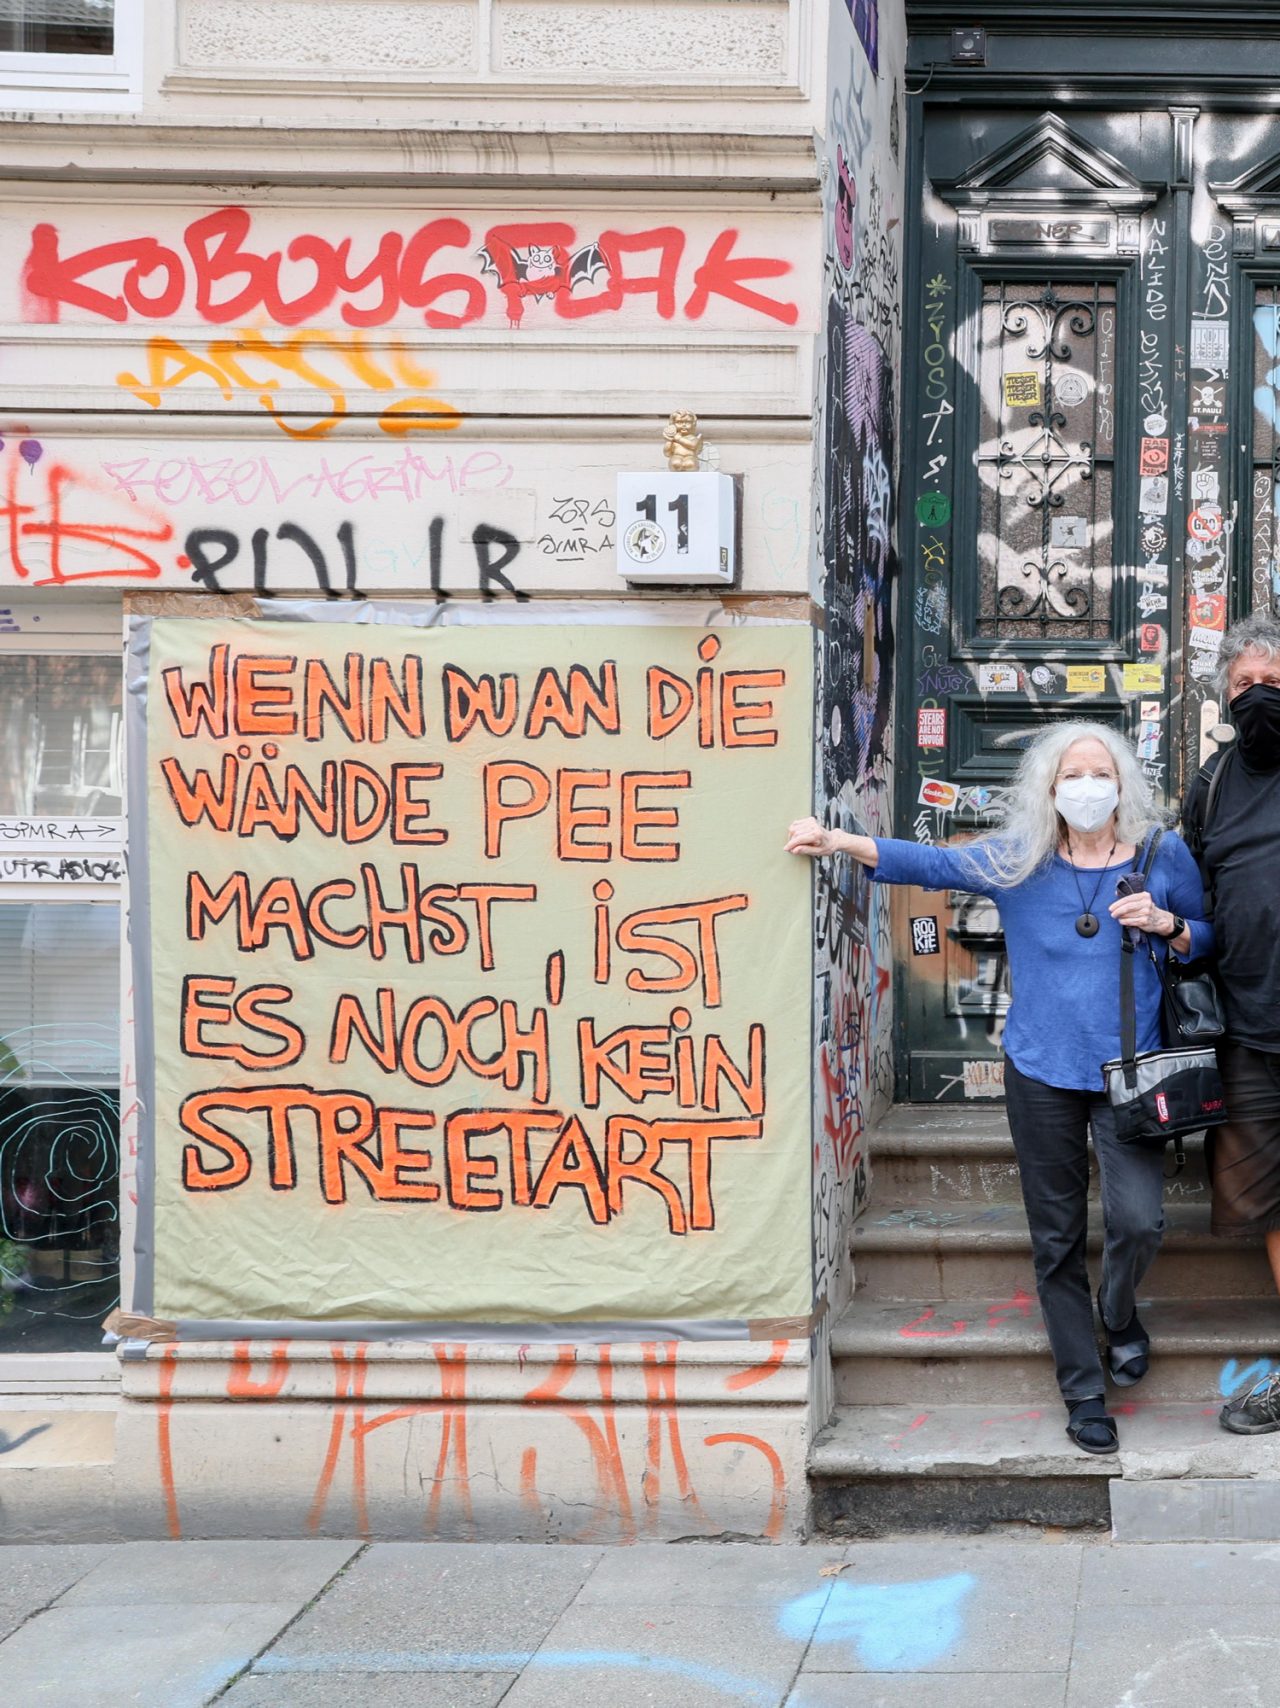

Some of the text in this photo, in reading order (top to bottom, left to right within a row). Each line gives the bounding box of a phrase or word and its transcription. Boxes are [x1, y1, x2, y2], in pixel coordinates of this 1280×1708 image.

[636, 494, 689, 554] 11
[162, 642, 426, 744] WENN
[443, 662, 519, 742] DU
[526, 659, 619, 740] AN
[918, 735, 945, 746] ENOUGH
[161, 743, 693, 862] WÄNDE PEE
[180, 975, 308, 1072] ES
[329, 988, 554, 1105] NOCH
[180, 1084, 763, 1236] STREETART
